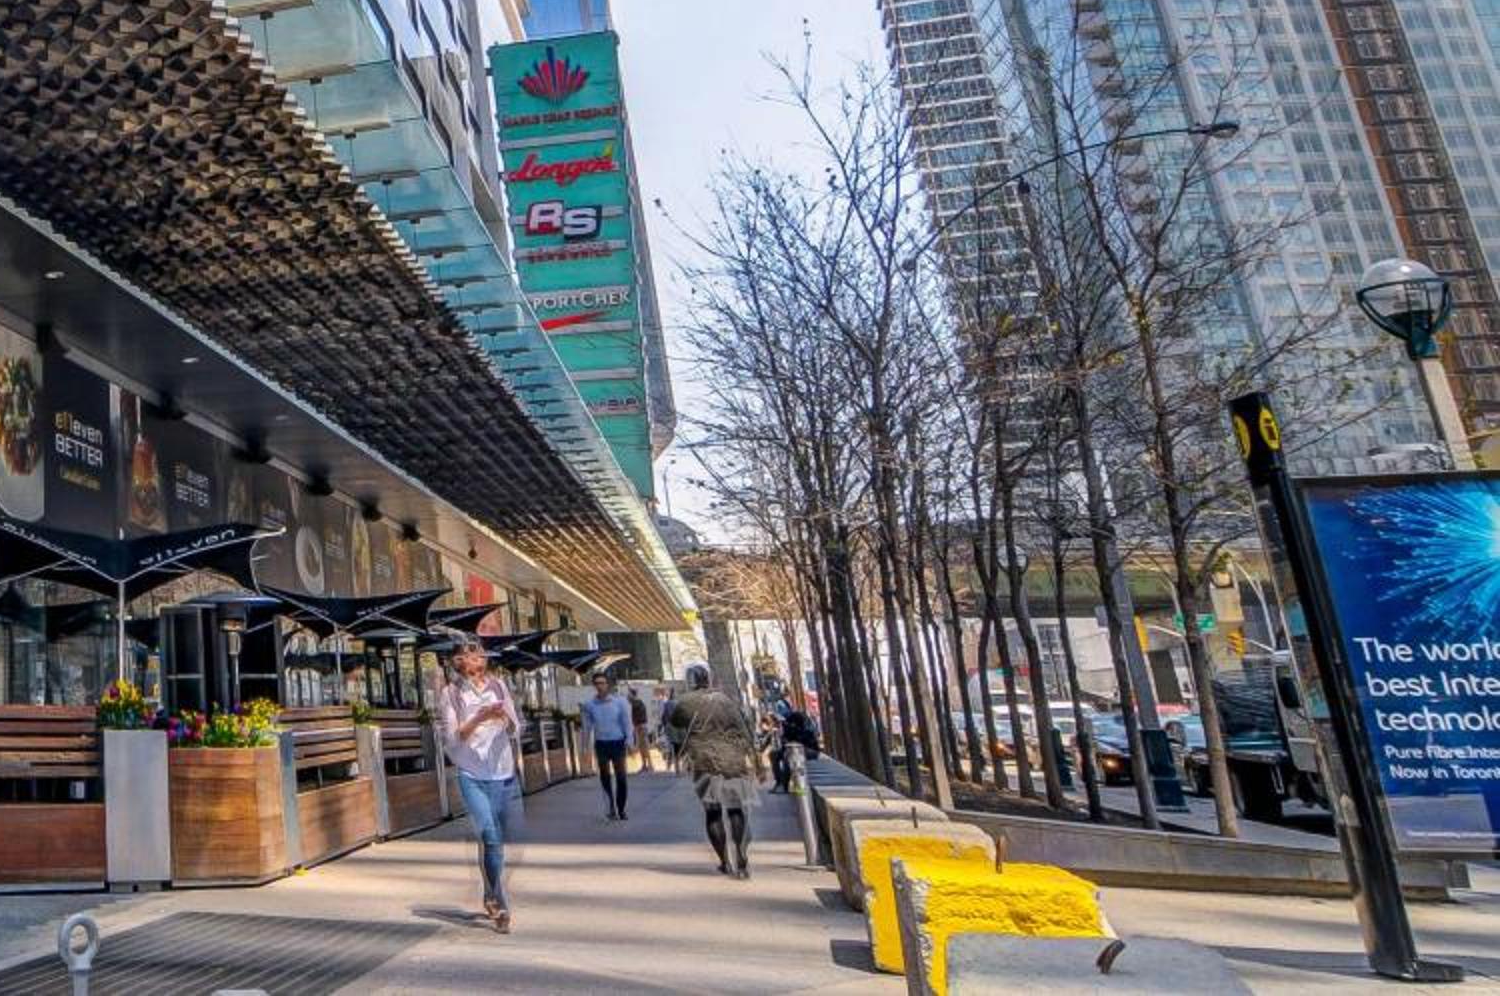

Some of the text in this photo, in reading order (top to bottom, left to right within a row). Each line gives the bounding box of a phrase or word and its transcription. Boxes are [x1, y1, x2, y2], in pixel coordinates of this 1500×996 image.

[527, 200, 600, 238] RS
[527, 290, 631, 310] PORTCHEK
[1353, 637, 1414, 662] The
[1365, 671, 1437, 697] best
[1384, 745, 1424, 759] Pure
[1389, 764, 1428, 779] Now
[1432, 765, 1449, 779] in
